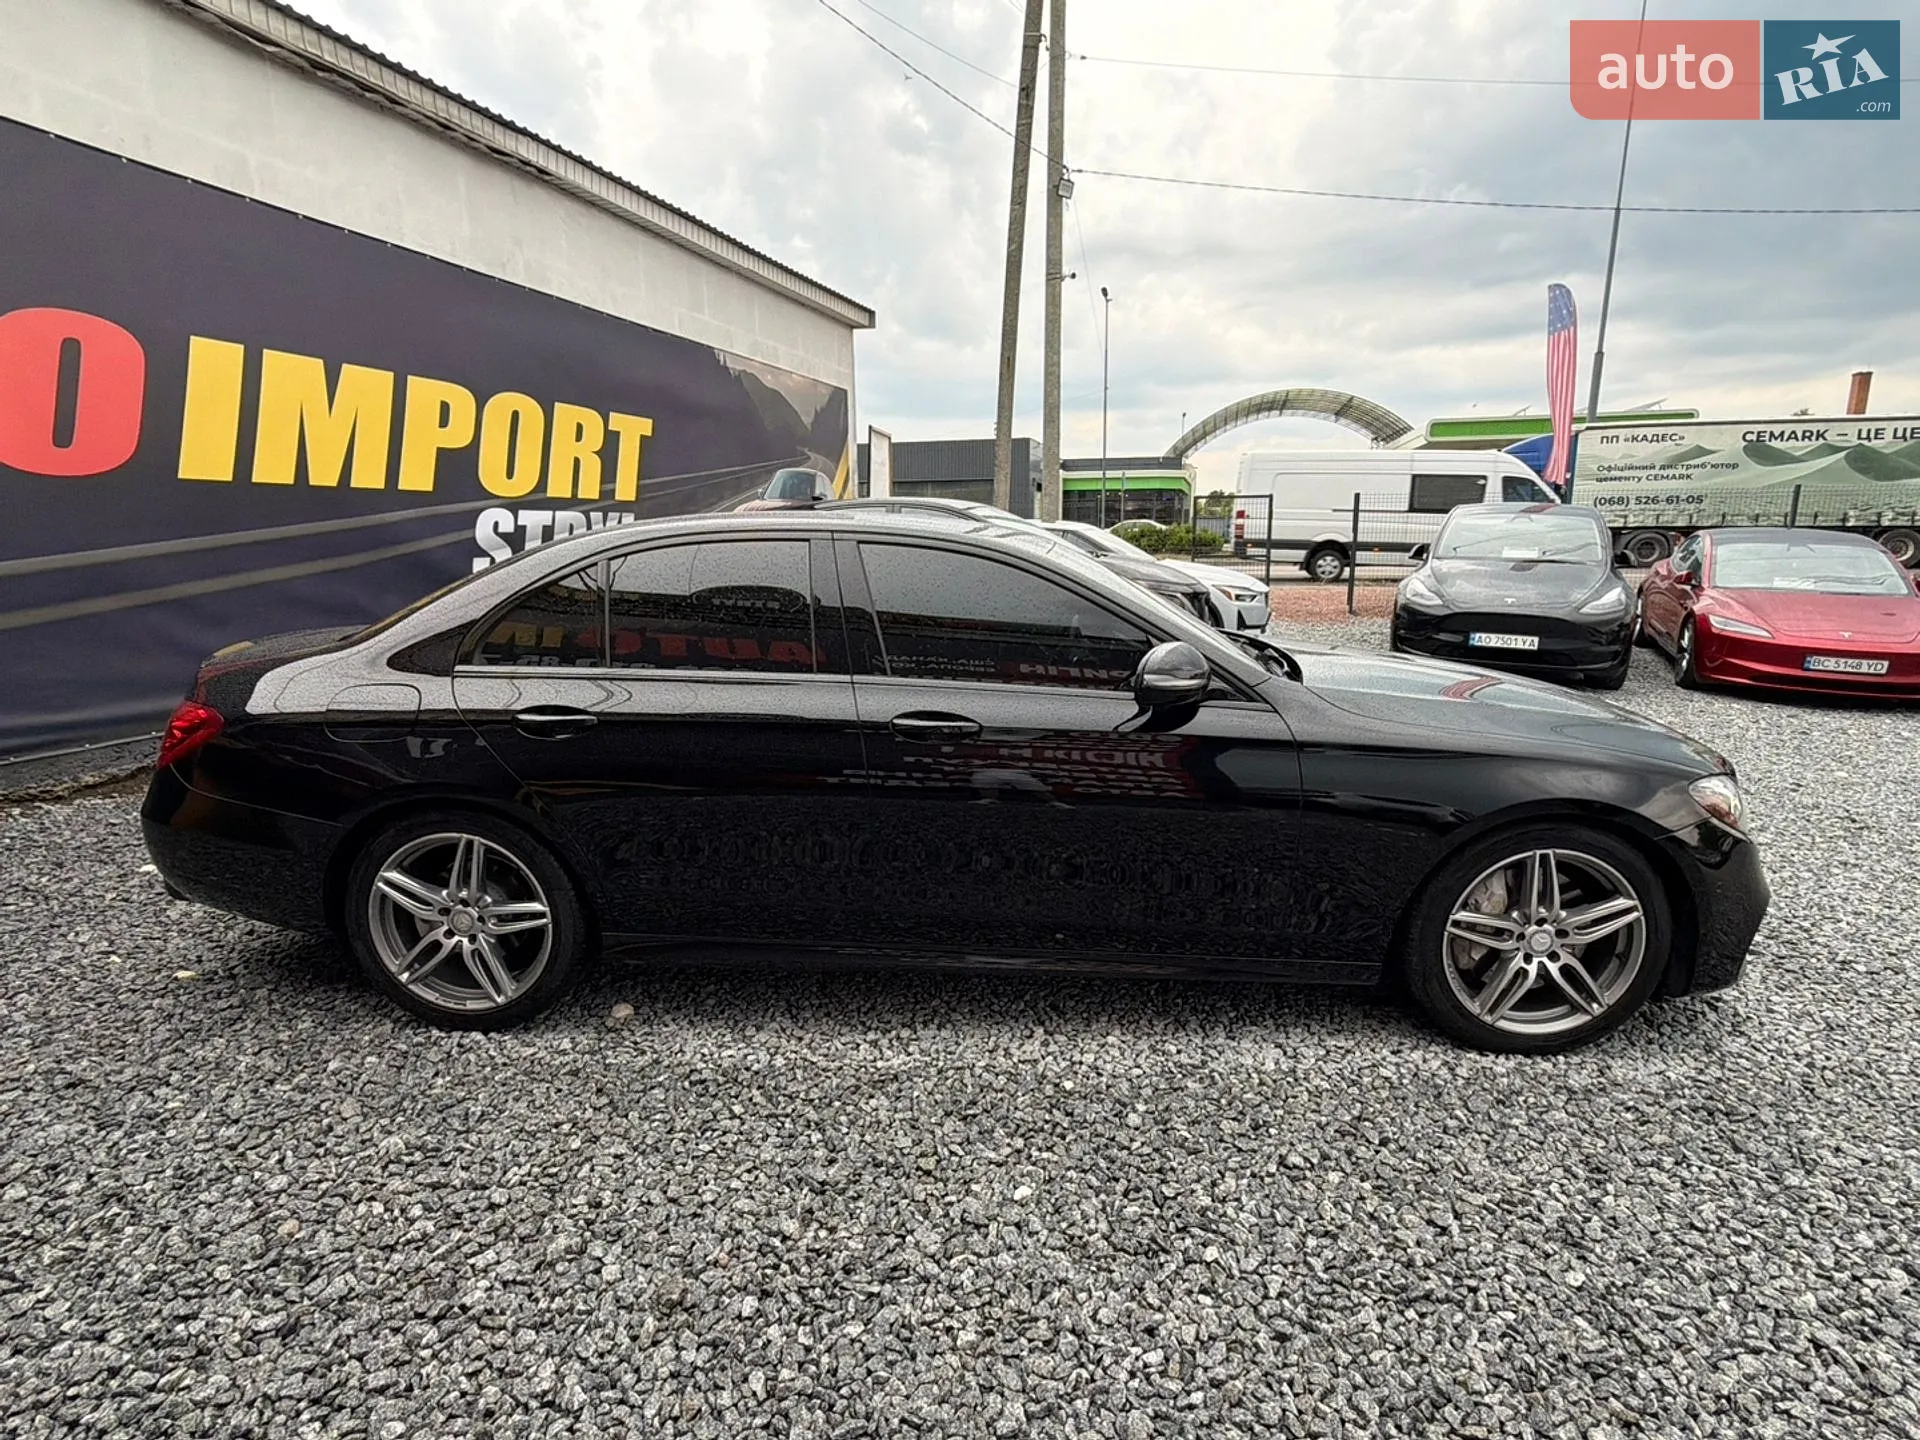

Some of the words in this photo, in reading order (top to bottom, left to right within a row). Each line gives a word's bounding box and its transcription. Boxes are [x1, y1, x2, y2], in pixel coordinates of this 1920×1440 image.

[177, 334, 654, 502] IMPORT
[1600, 434, 1620, 445] ПП
[1742, 428, 1830, 443] CEMARK
[1857, 427, 1886, 443] ЦЕ
[1597, 463, 1657, 473] Офіційний
[1595, 474, 1643, 484] цементу
[1646, 473, 1694, 482] CEMARK
[1593, 495, 1630, 508] (068)
[1634, 494, 1705, 506] 526-61-05
[1812, 657, 1831, 668] BC
[1833, 660, 1862, 671] 5148
[1866, 662, 1885, 672] YD
